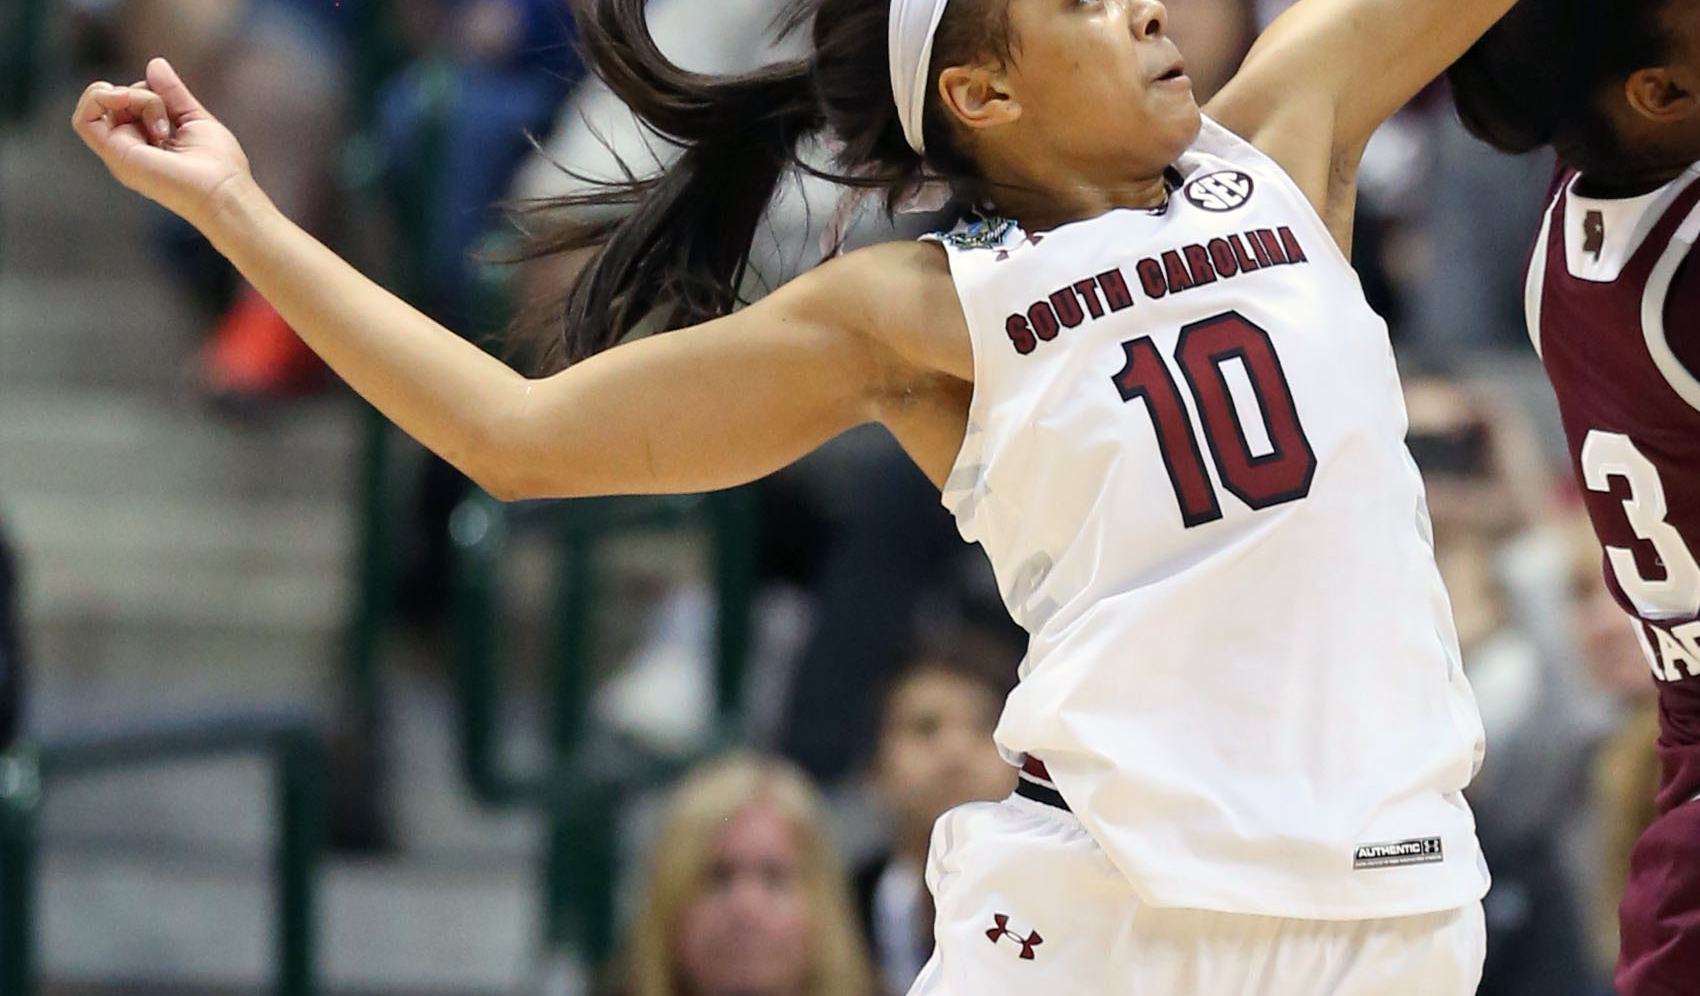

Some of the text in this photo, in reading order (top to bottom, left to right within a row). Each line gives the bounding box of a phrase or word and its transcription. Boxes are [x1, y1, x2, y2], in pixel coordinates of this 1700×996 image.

[1189, 171, 1250, 210] SEC
[1005, 226, 1308, 355] SOUTH CAROLINA
[1111, 309, 1318, 530] 10
[1357, 843, 1421, 859] AUTHENTIC
